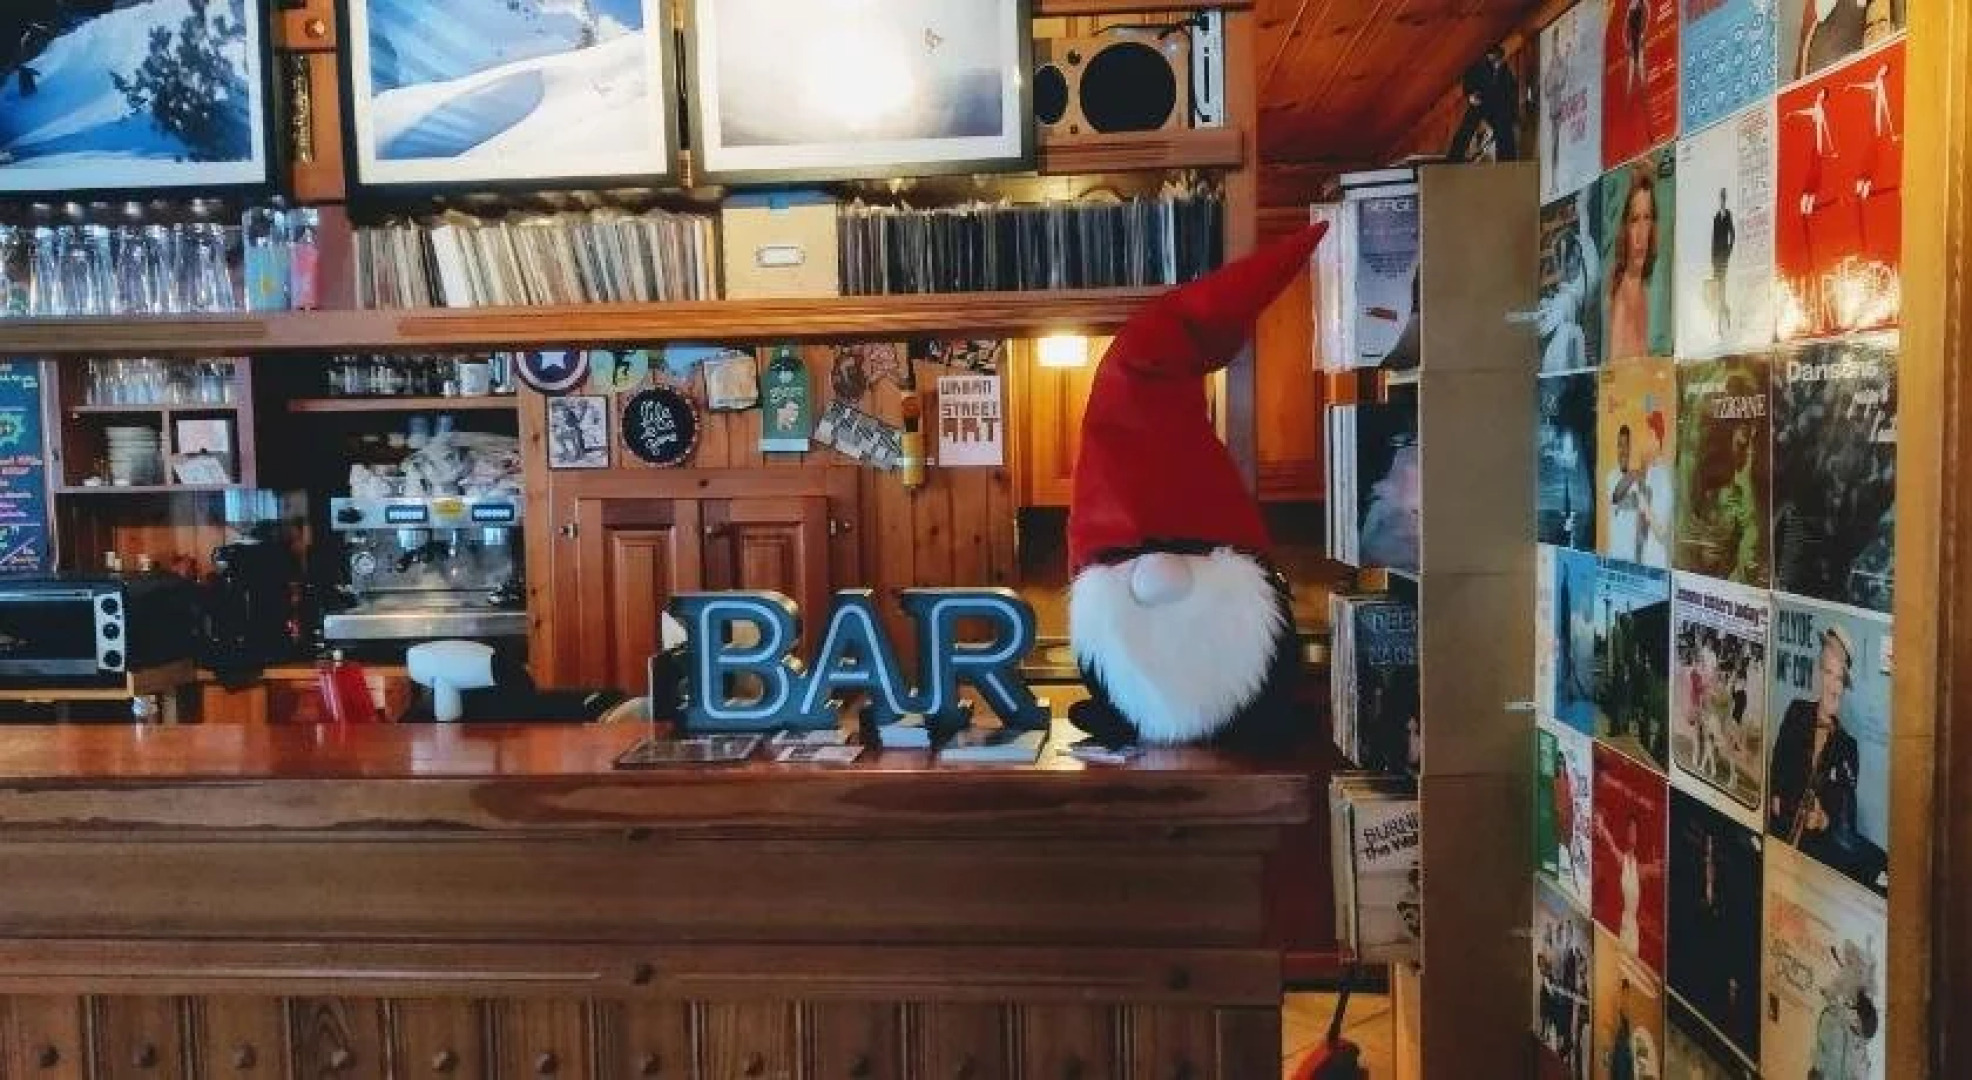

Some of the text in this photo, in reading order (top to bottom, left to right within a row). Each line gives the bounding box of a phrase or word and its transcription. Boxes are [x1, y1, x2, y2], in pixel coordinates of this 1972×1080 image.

[940, 379, 992, 395] URBAN
[941, 401, 997, 417] STREET
[942, 417, 1000, 443] ART
[672, 588, 1046, 732] BAR
